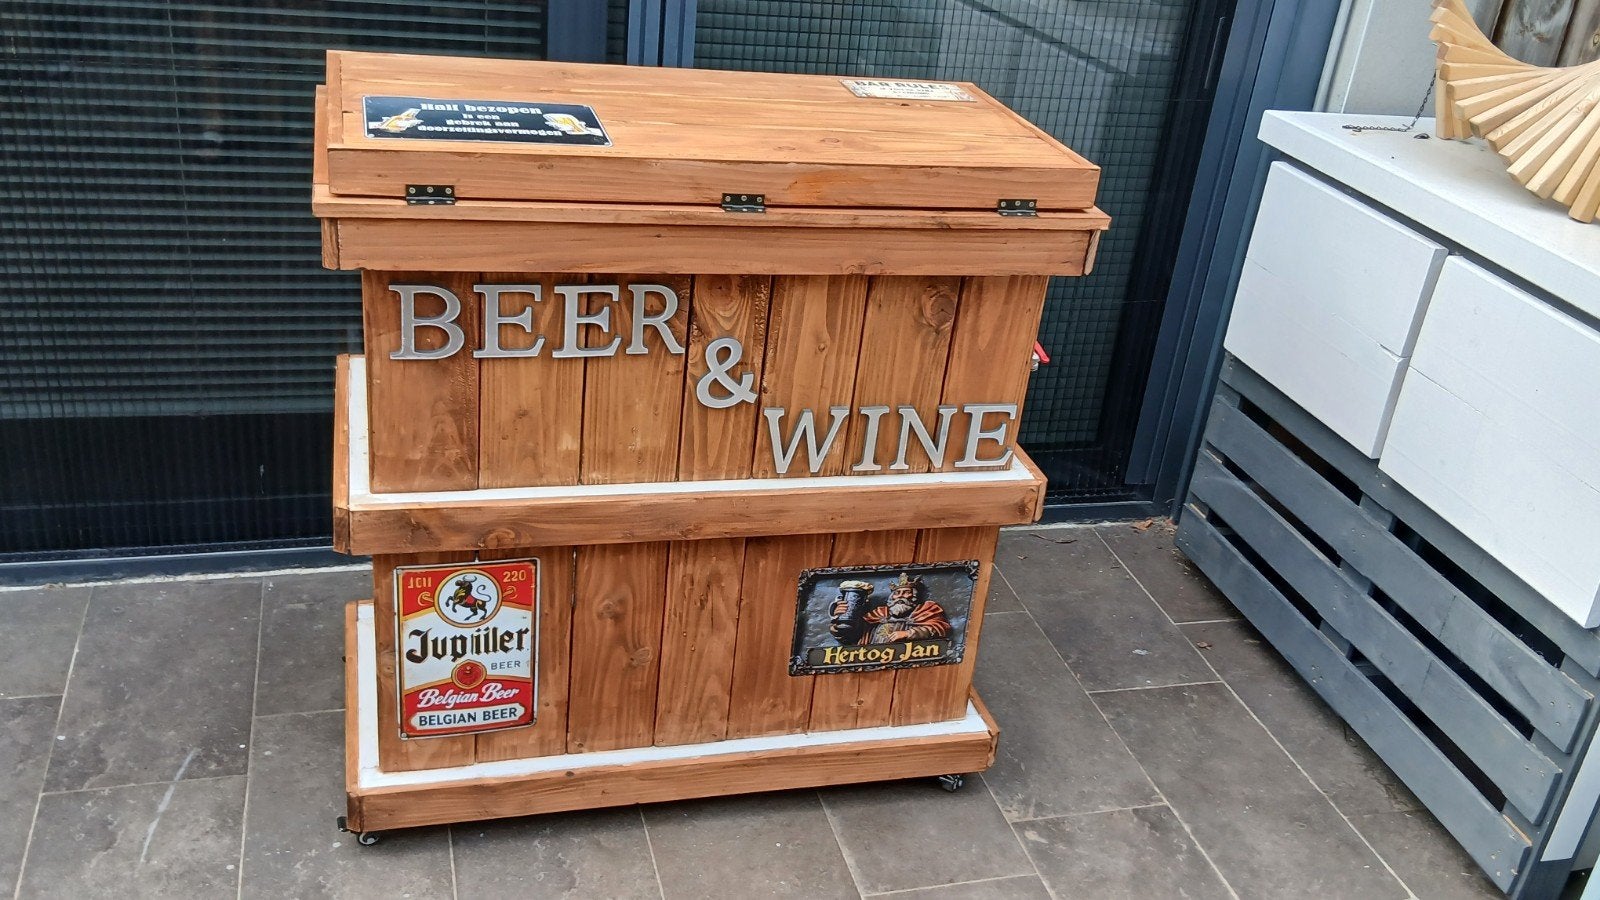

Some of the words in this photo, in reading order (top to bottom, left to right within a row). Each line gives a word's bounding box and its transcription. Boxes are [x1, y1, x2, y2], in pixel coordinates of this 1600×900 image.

[420, 103, 459, 111] Half
[464, 104, 543, 115] bezopen
[446, 119, 492, 127] gebrek
[388, 283, 685, 361] BEER
[695, 337, 759, 409] &
[763, 403, 1018, 474] WINE
[503, 570, 527, 583] 220
[490, 660, 521, 670] BEER
[822, 645, 895, 666] Hertog
[899, 641, 939, 662] Jan
[417, 688, 479, 709] Belgian
[479, 682, 520, 702] Beer
[419, 711, 477, 727] BELGIAN
[482, 706, 518, 721] BEER
